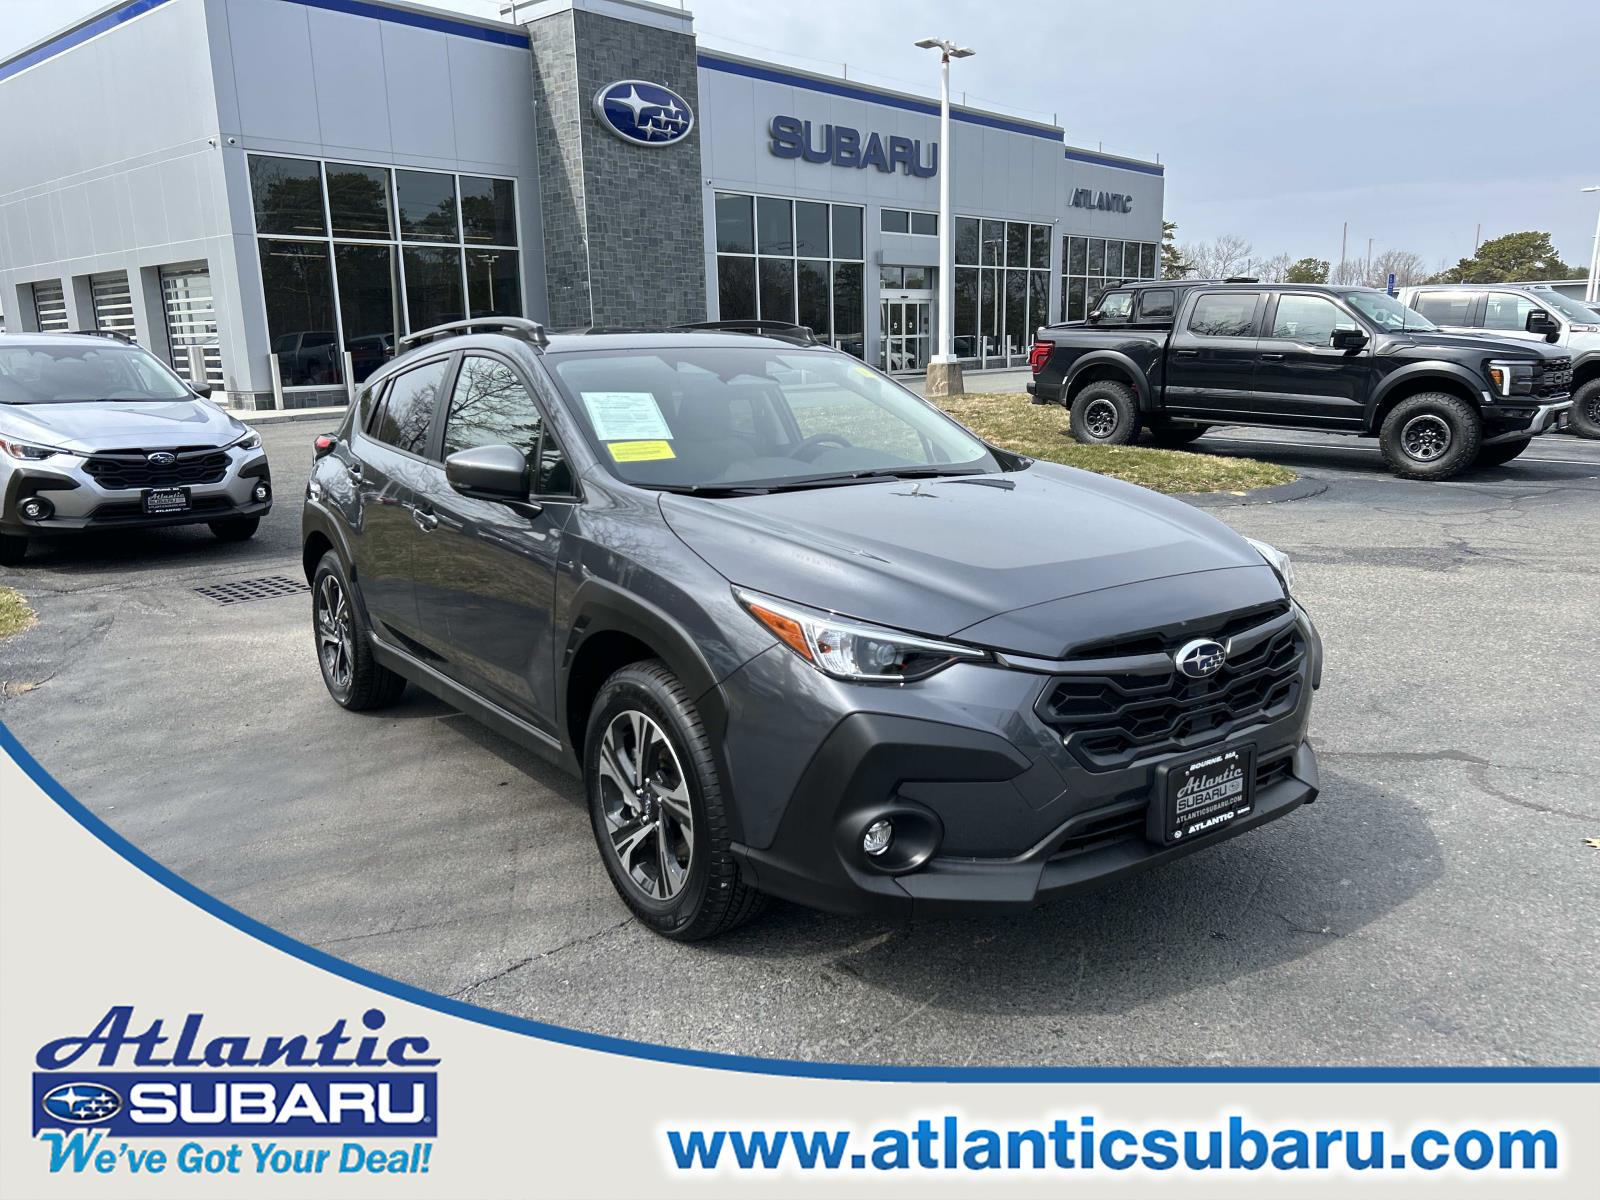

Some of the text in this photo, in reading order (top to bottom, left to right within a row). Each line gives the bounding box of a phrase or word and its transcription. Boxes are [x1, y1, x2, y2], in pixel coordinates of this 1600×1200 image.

[769, 115, 938, 178] SUBARU
[1068, 187, 1133, 213] ATLANTIC
[1177, 764, 1243, 798] Atlantic
[1176, 795, 1242, 824] ATLANTICSUBARU.COM
[1178, 785, 1227, 810] SUBARU
[1188, 811, 1234, 833] ATLANTIC
